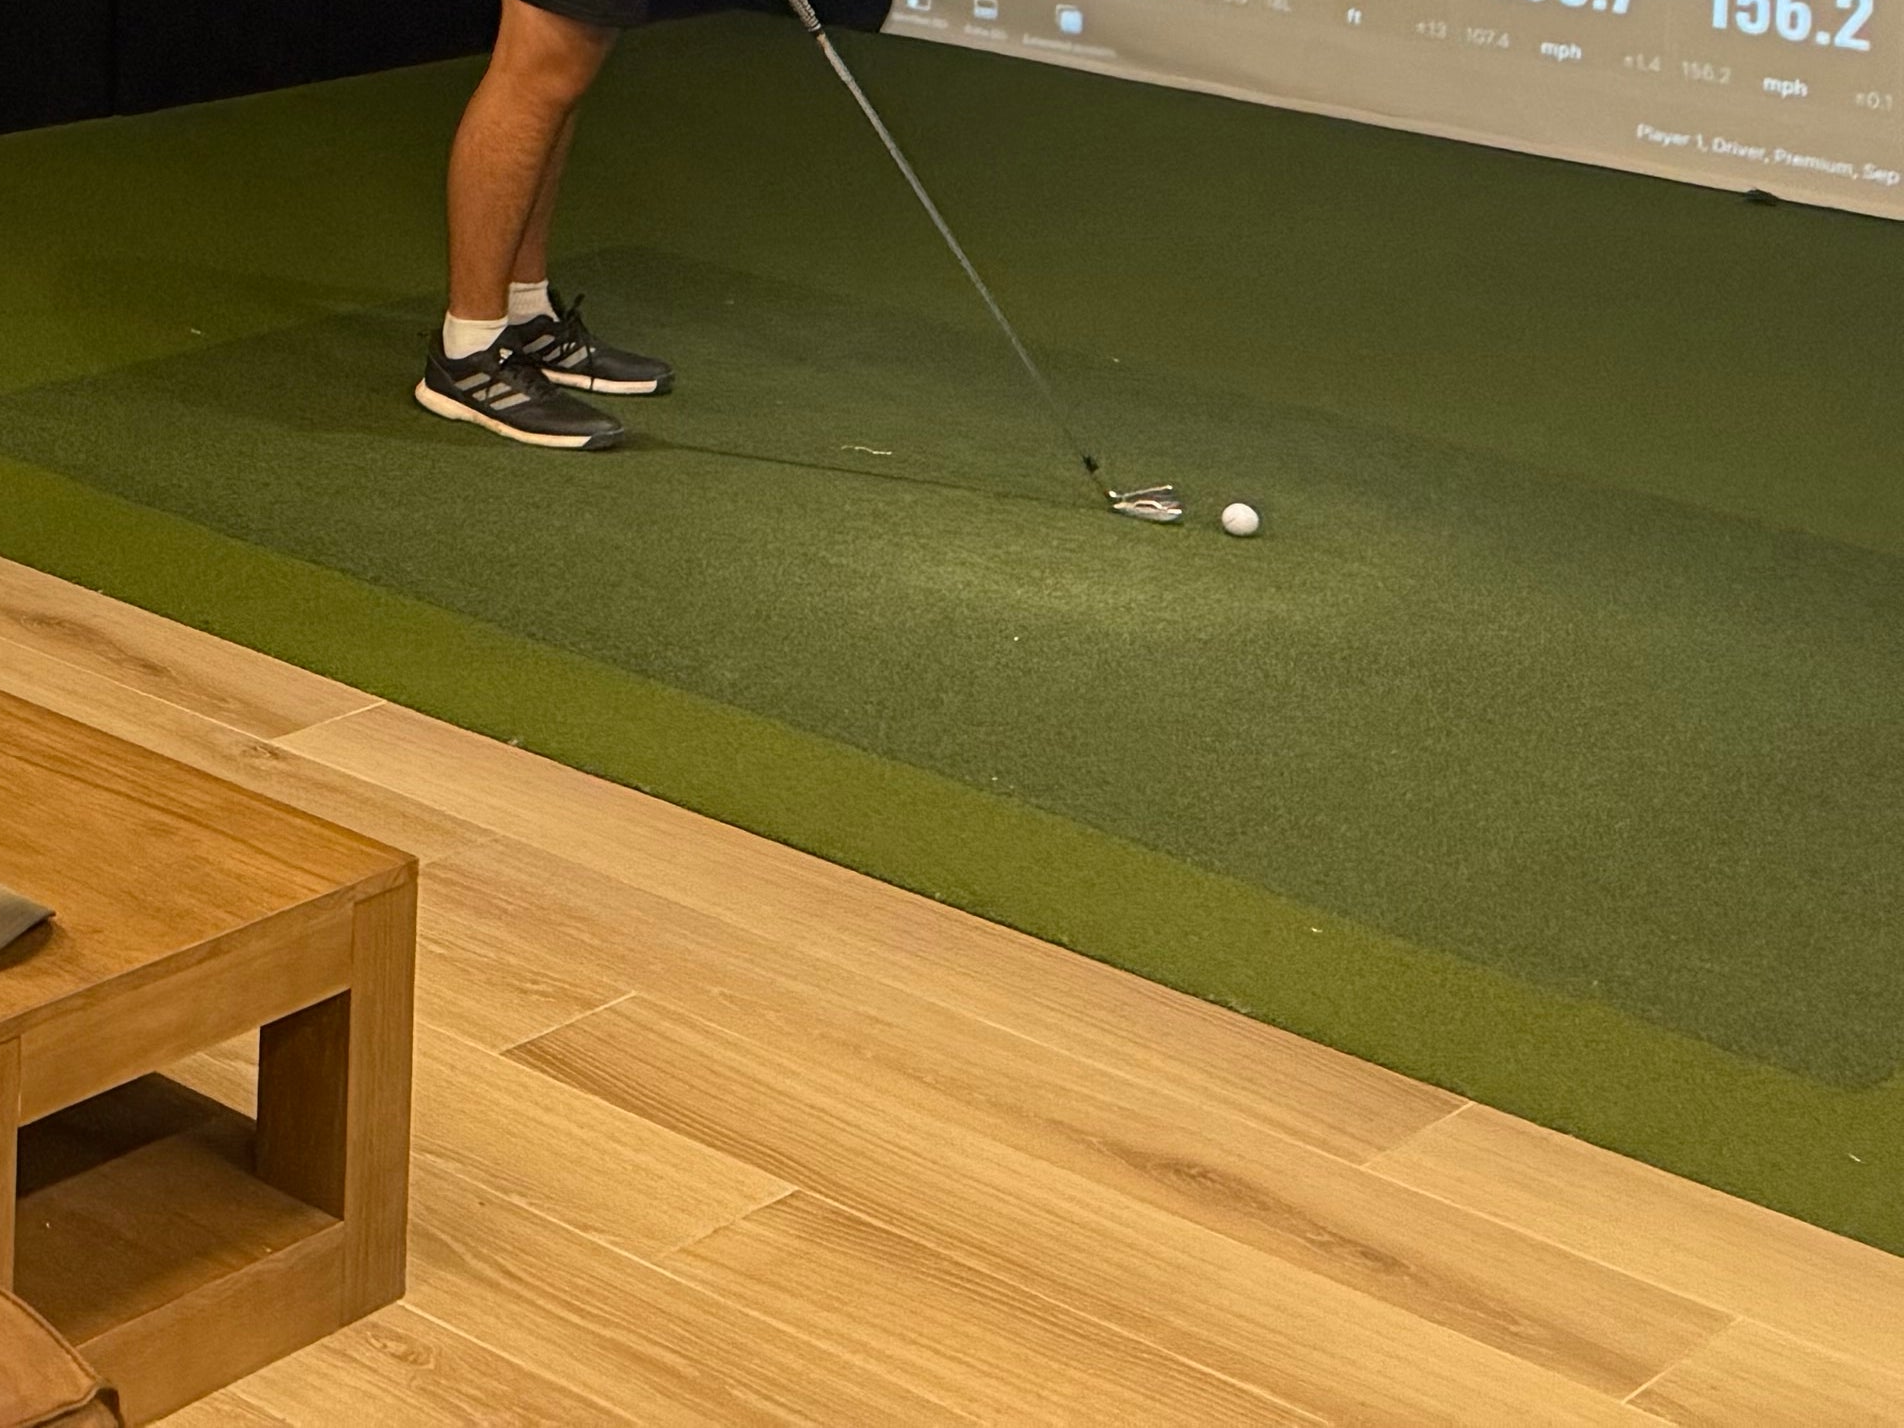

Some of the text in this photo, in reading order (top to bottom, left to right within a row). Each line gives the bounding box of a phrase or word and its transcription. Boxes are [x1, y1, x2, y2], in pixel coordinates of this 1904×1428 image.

[1347, 7, 1362, 25] ft
[1540, 38, 1583, 62] mph
[1762, 75, 1808, 99] mph
[1636, 122, 1690, 148] Player
[1712, 135, 1770, 164] Driver,
[1773, 148, 1859, 180] Premium,
[1862, 162, 1901, 186] Sep
